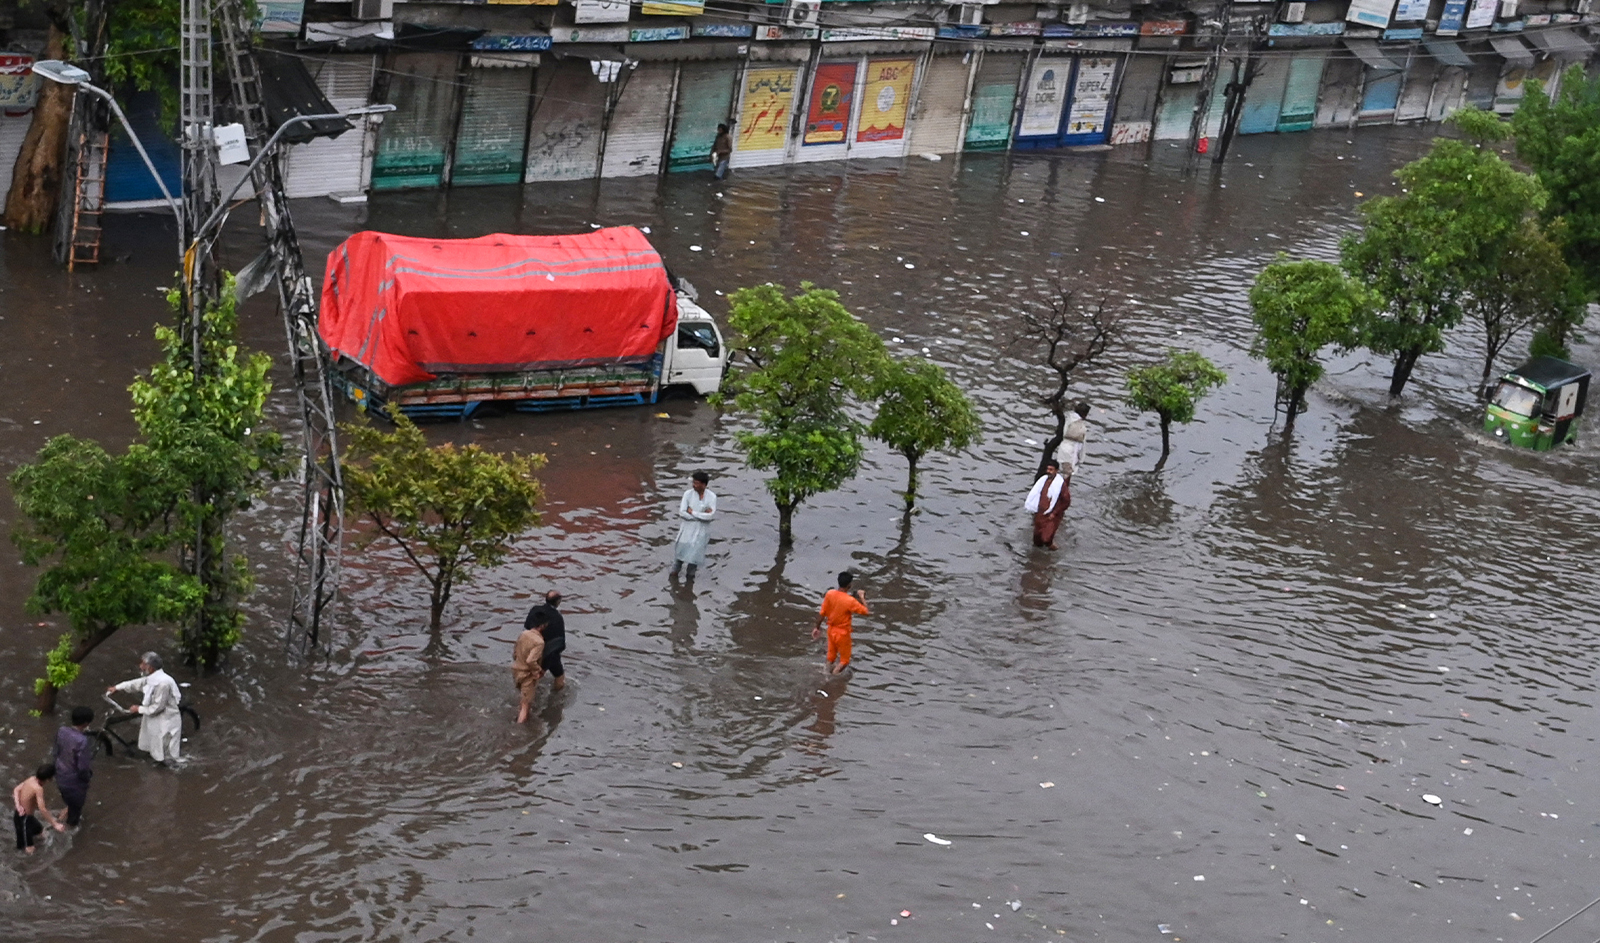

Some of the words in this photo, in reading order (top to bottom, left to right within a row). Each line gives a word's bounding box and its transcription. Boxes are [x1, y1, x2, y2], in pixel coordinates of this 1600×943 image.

[879, 67, 900, 81] ABC
[1037, 80, 1056, 91] WELL
[1078, 80, 1100, 93] SUPER
[1100, 72, 1110, 91] Z
[826, 88, 838, 105] 7
[1035, 92, 1056, 103] DONE
